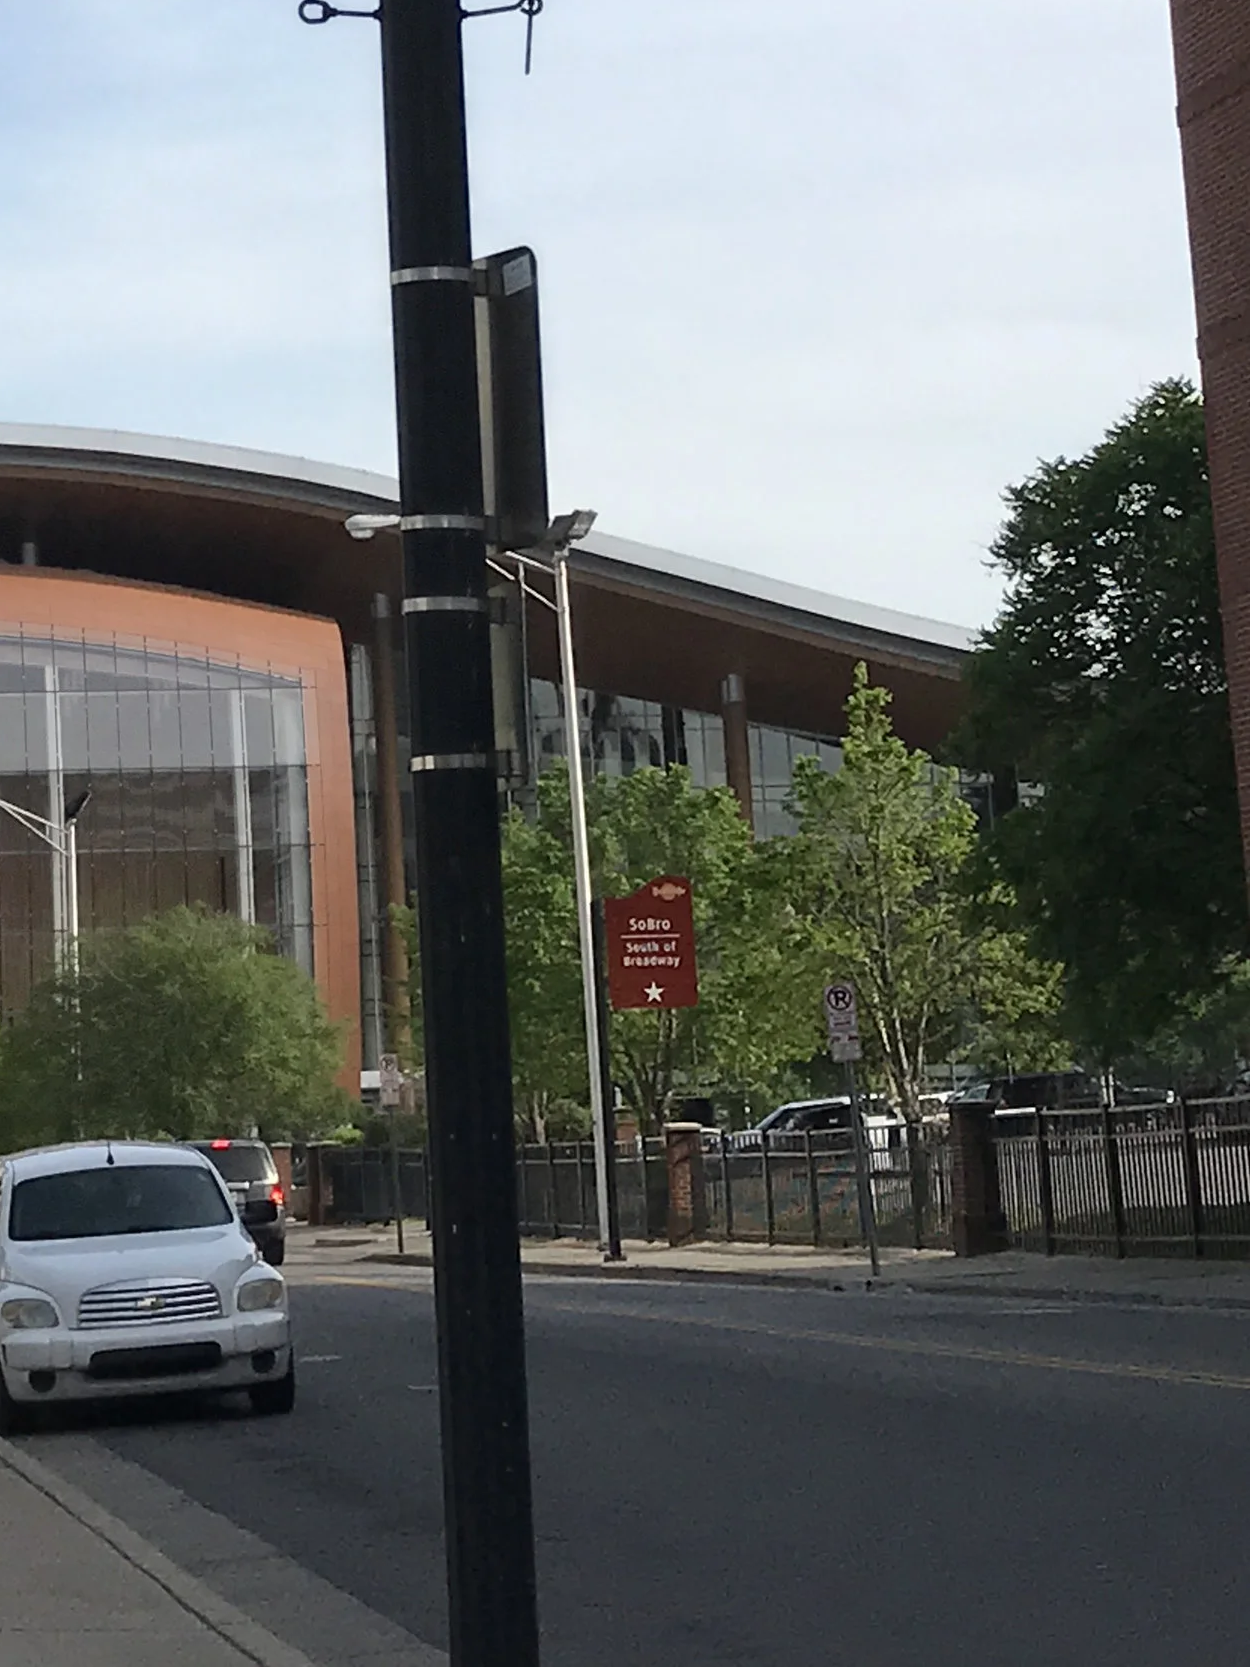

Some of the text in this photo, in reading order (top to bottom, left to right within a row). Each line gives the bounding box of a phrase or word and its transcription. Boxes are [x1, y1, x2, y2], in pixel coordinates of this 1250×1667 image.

[629, 918, 671, 931] SoBro
[626, 940, 676, 953] South of
[623, 956, 681, 968] Broadway
